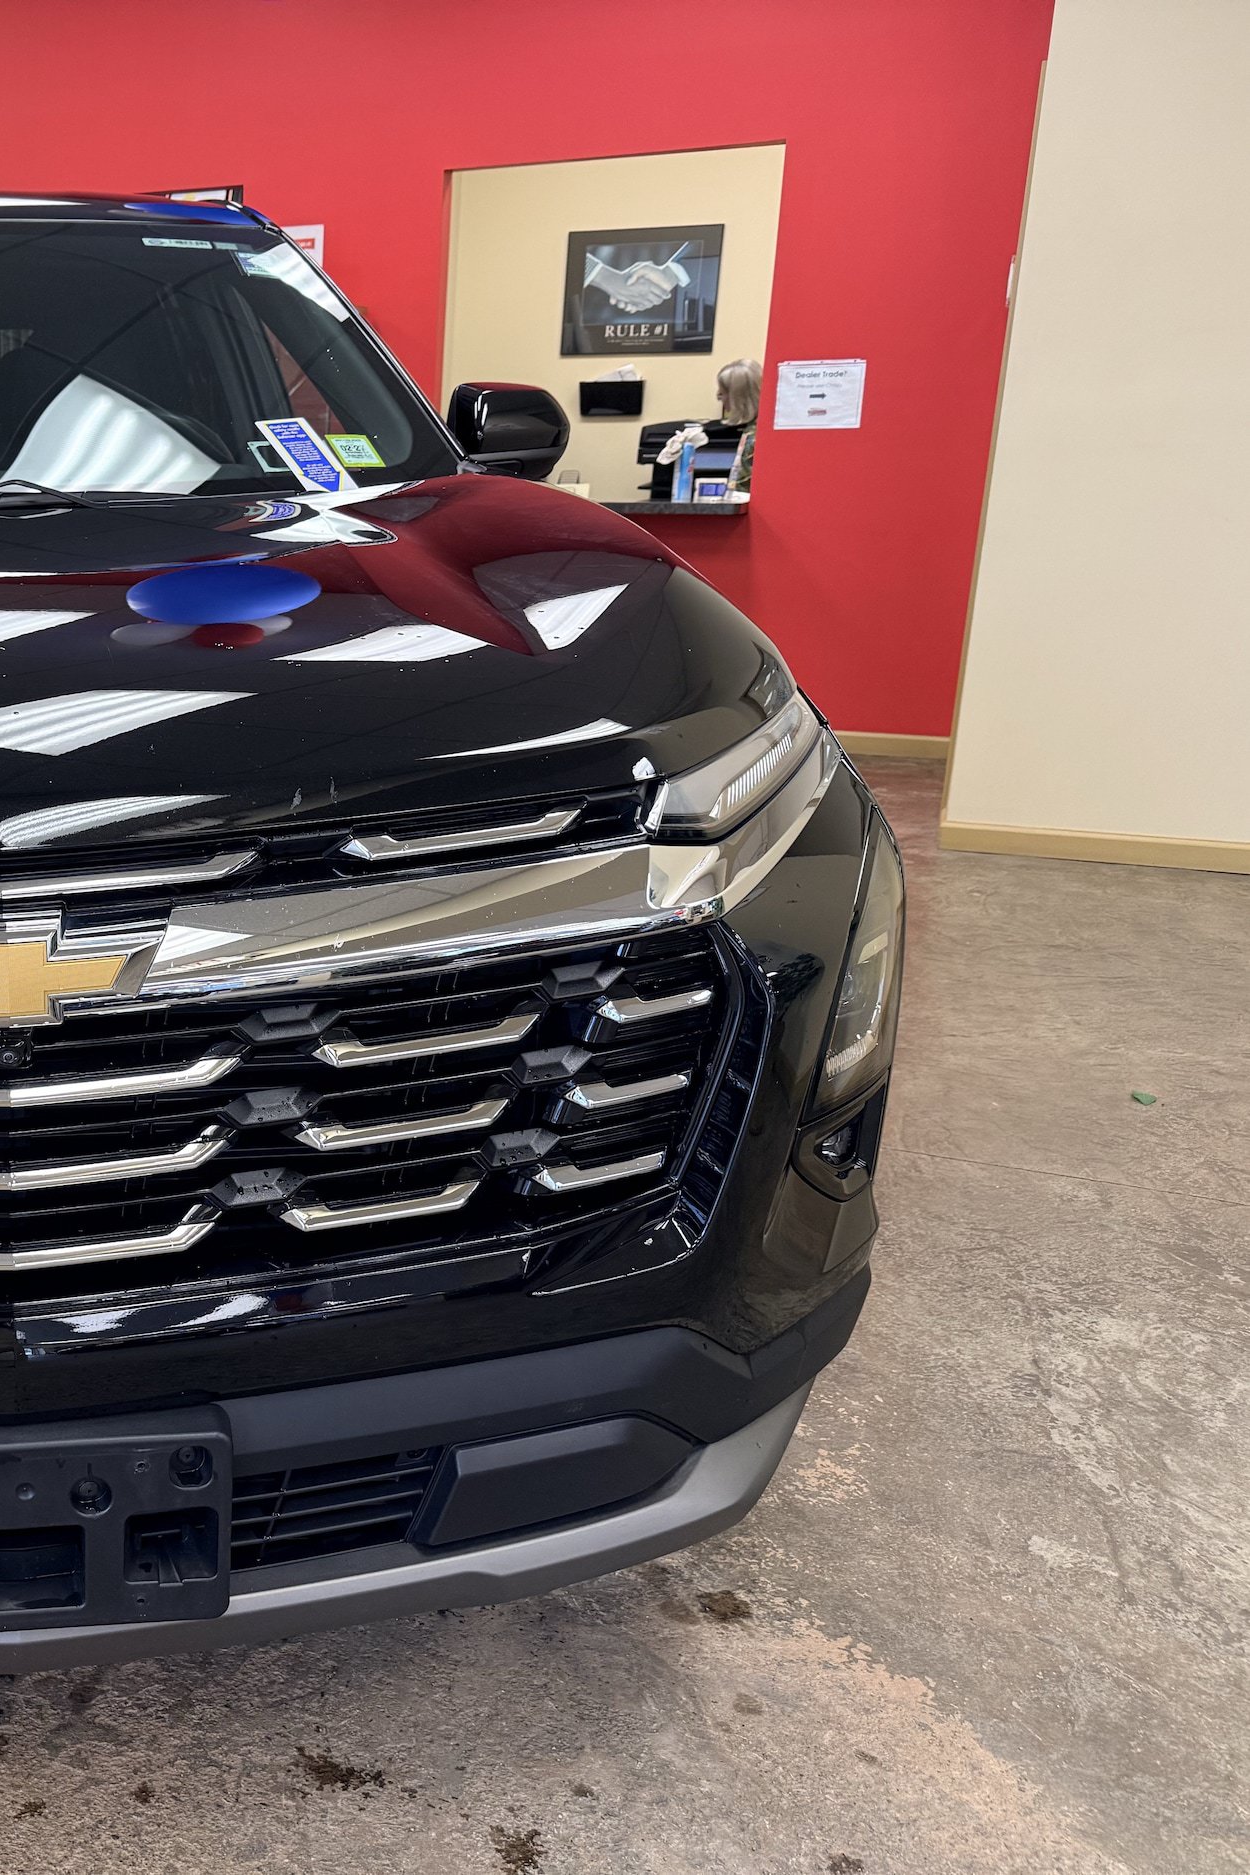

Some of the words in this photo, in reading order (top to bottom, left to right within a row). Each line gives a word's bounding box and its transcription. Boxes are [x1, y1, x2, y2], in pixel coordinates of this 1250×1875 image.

[604, 324, 650, 338] RULE
[654, 323, 668, 336] #1
[822, 370, 848, 378] Trade?
